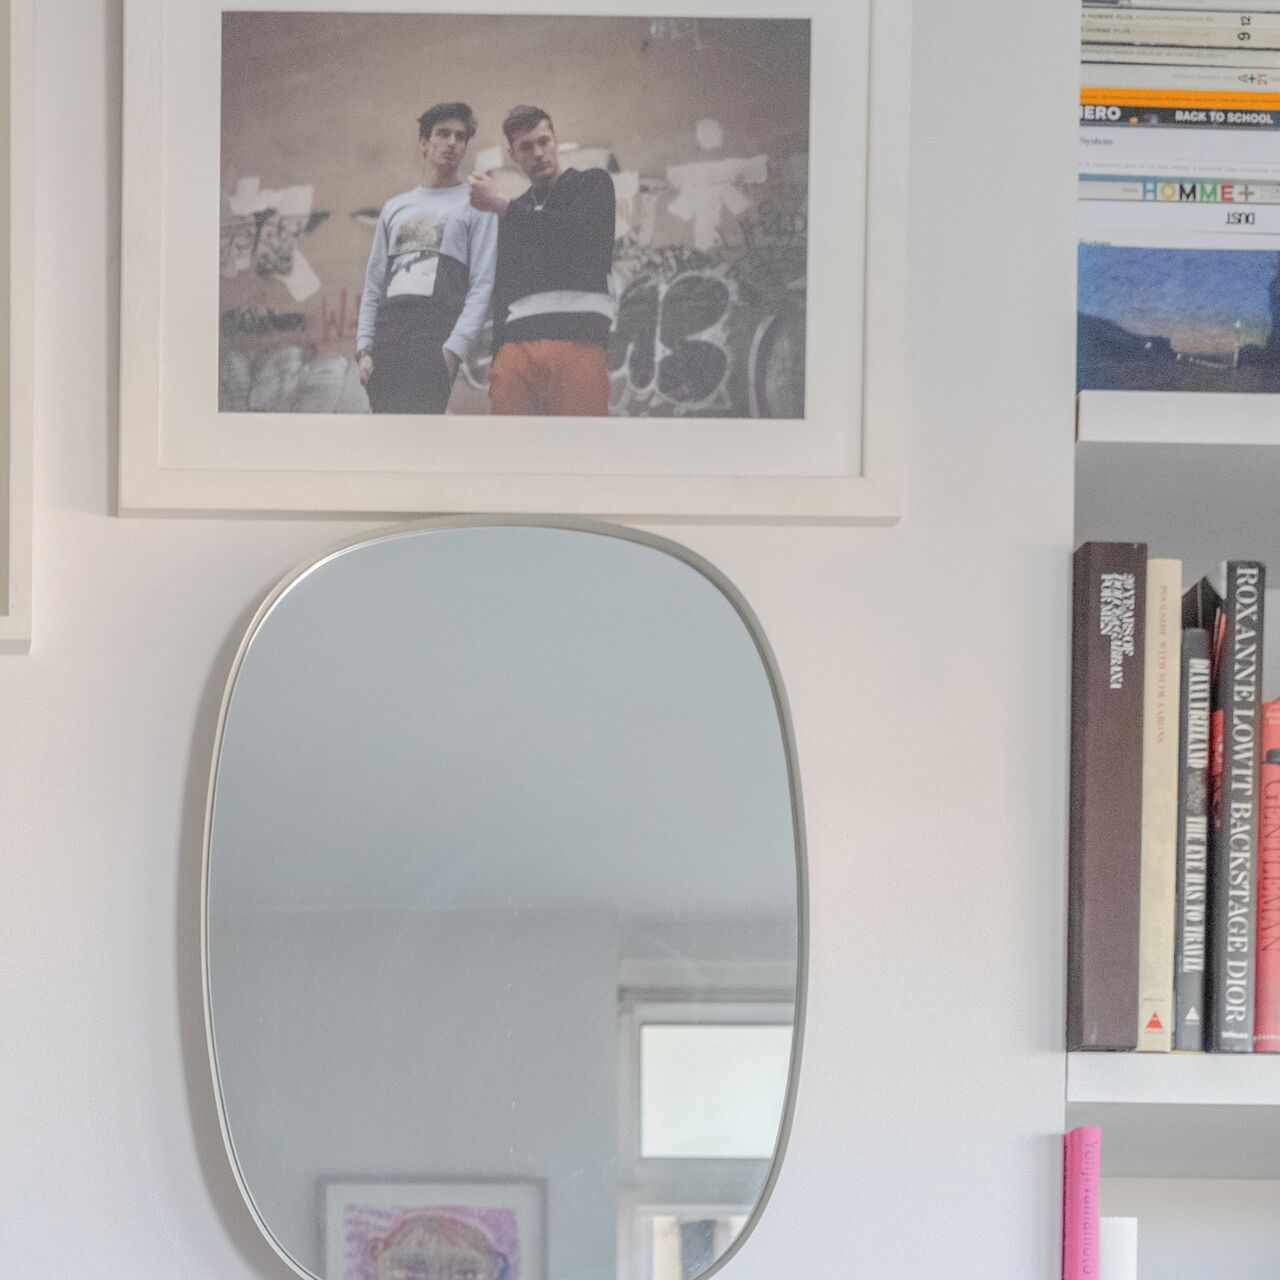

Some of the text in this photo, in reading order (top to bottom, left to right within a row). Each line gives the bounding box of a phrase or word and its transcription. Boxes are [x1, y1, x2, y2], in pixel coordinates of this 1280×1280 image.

[1175, 110, 1274, 124] BACK TO SCHOOL
[1233, 567, 1259, 702] ROXANNE
[1231, 708, 1255, 796] LOWIT
[1226, 802, 1252, 953] BACKSTAGE
[1183, 925, 1205, 973] TRAVEL
[1225, 960, 1248, 1022] DIOR
